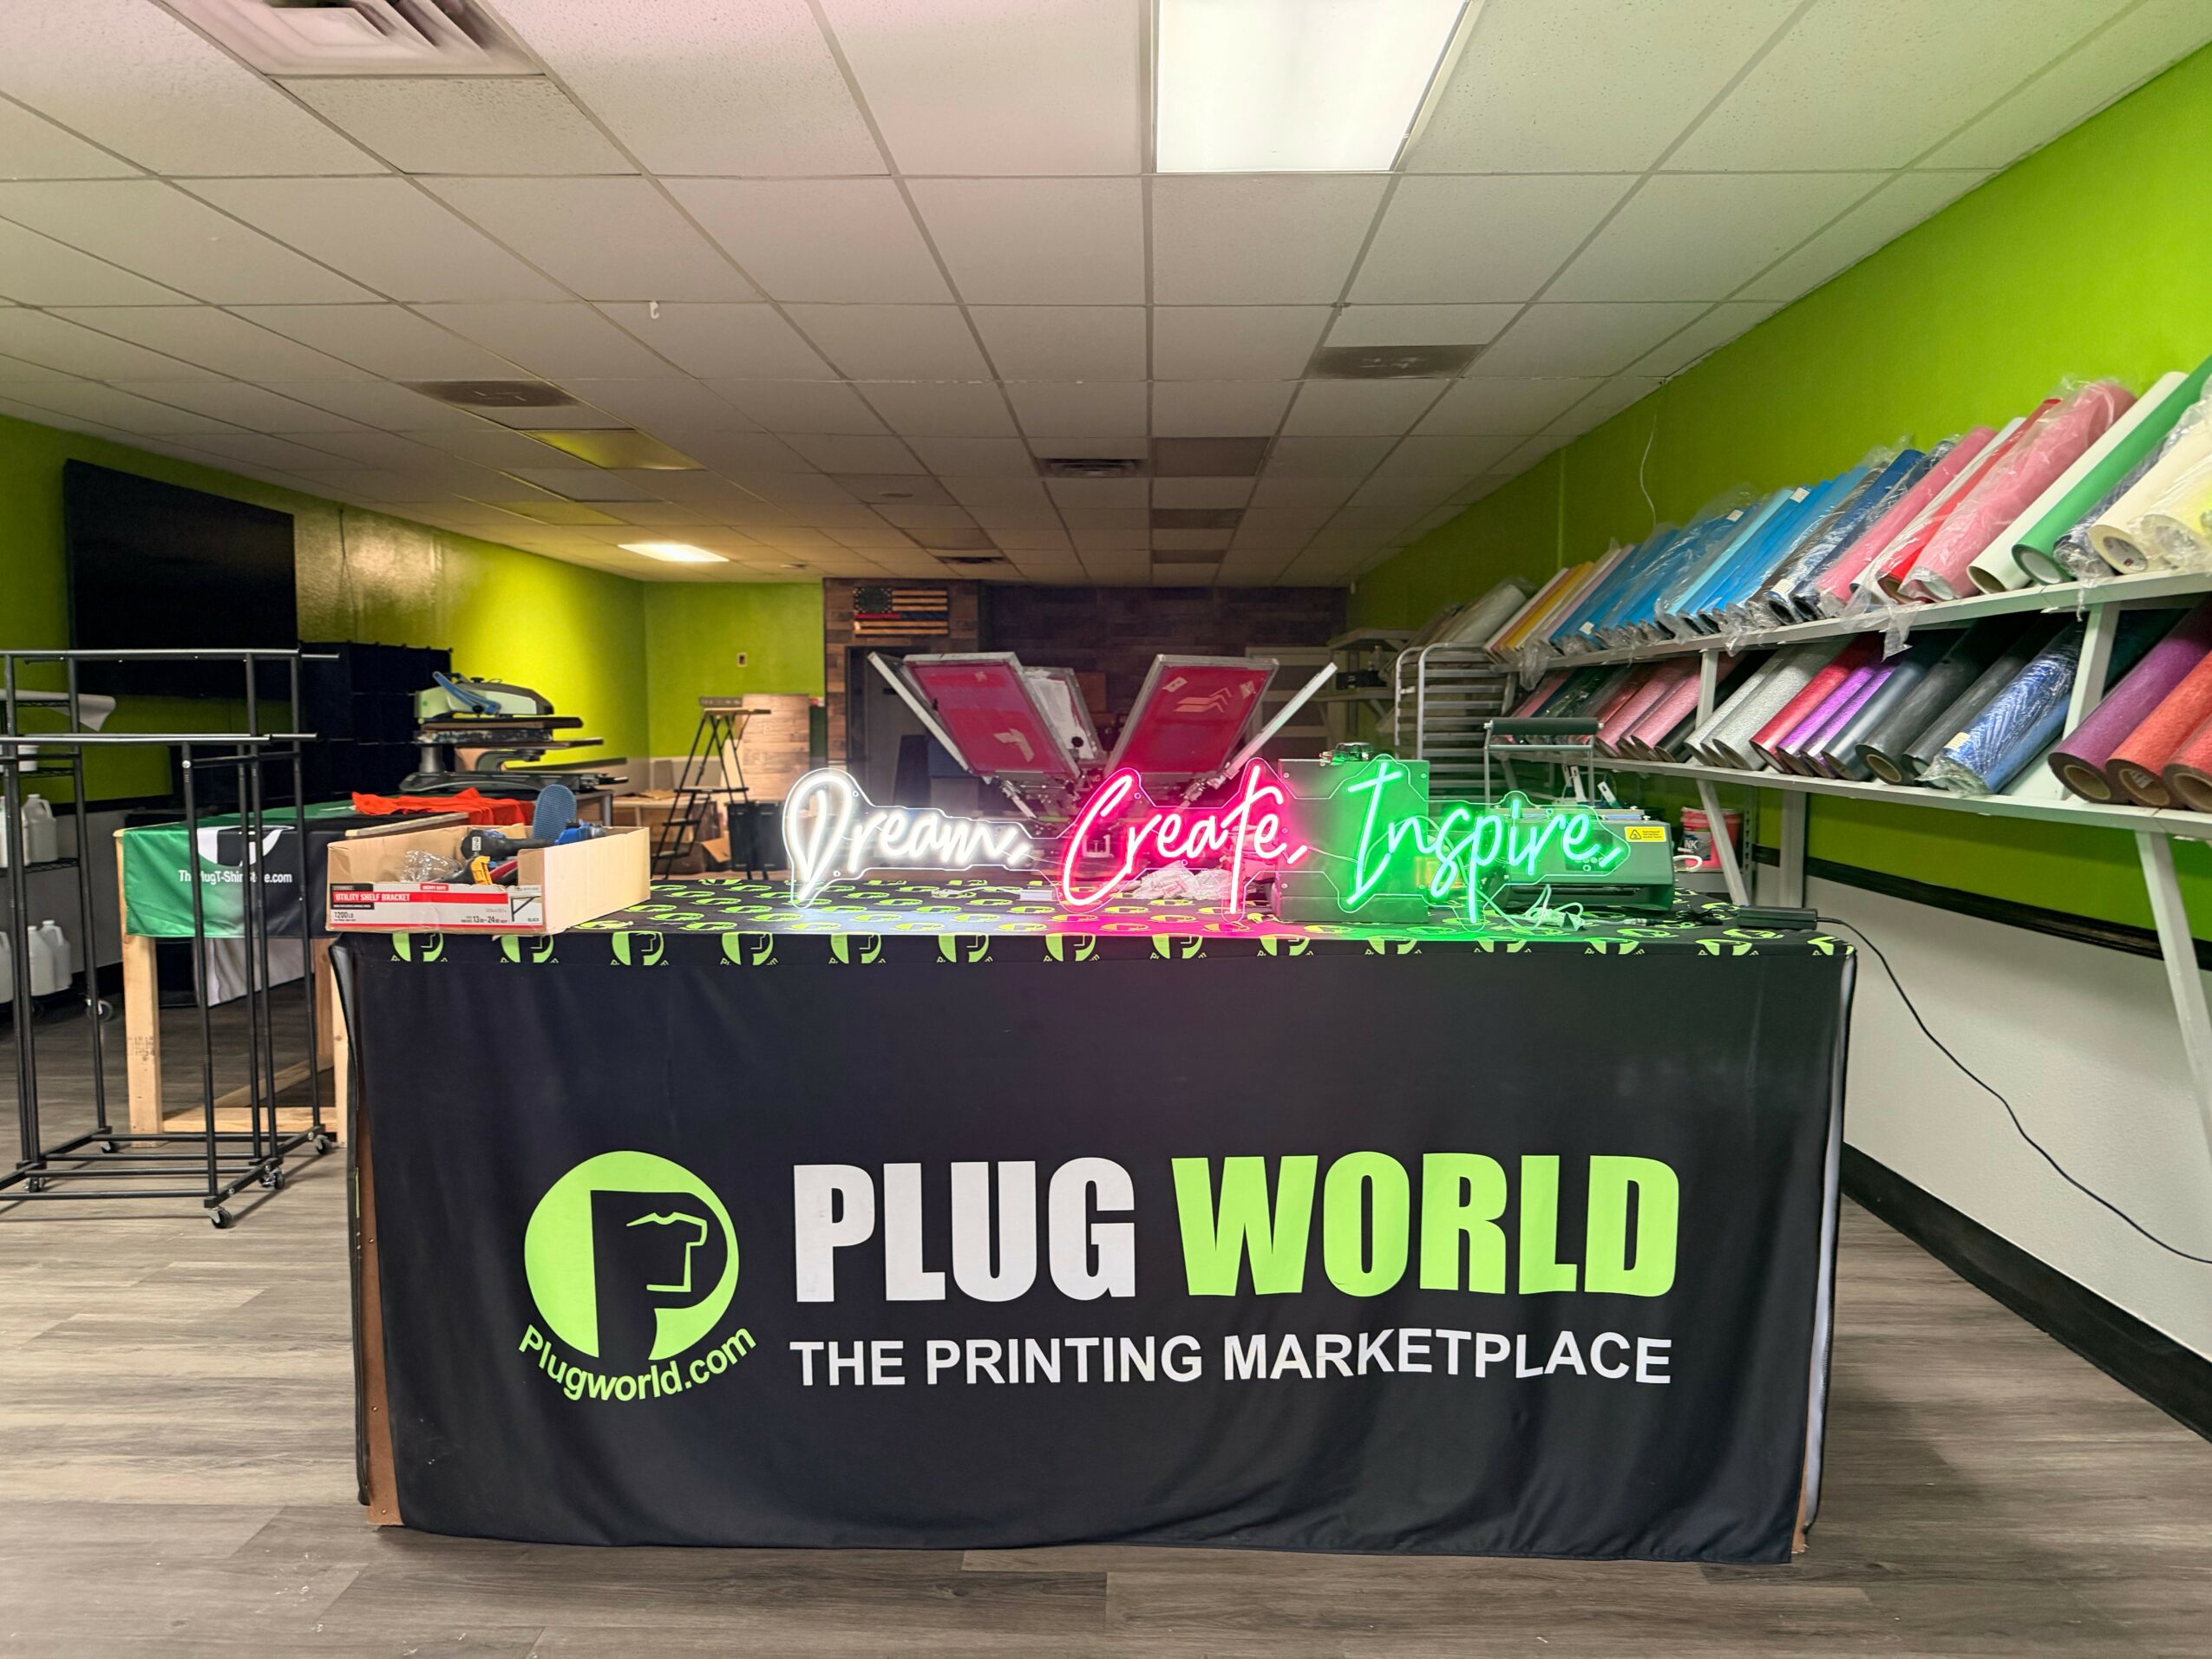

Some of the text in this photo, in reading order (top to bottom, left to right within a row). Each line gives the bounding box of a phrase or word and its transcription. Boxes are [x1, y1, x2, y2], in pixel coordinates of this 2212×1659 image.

[794, 1151, 1679, 1302] PLUG WORLD
[518, 1323, 757, 1401] Plugworld.com
[789, 1328, 1672, 1387] THE PRINTING MARKETPLACE
